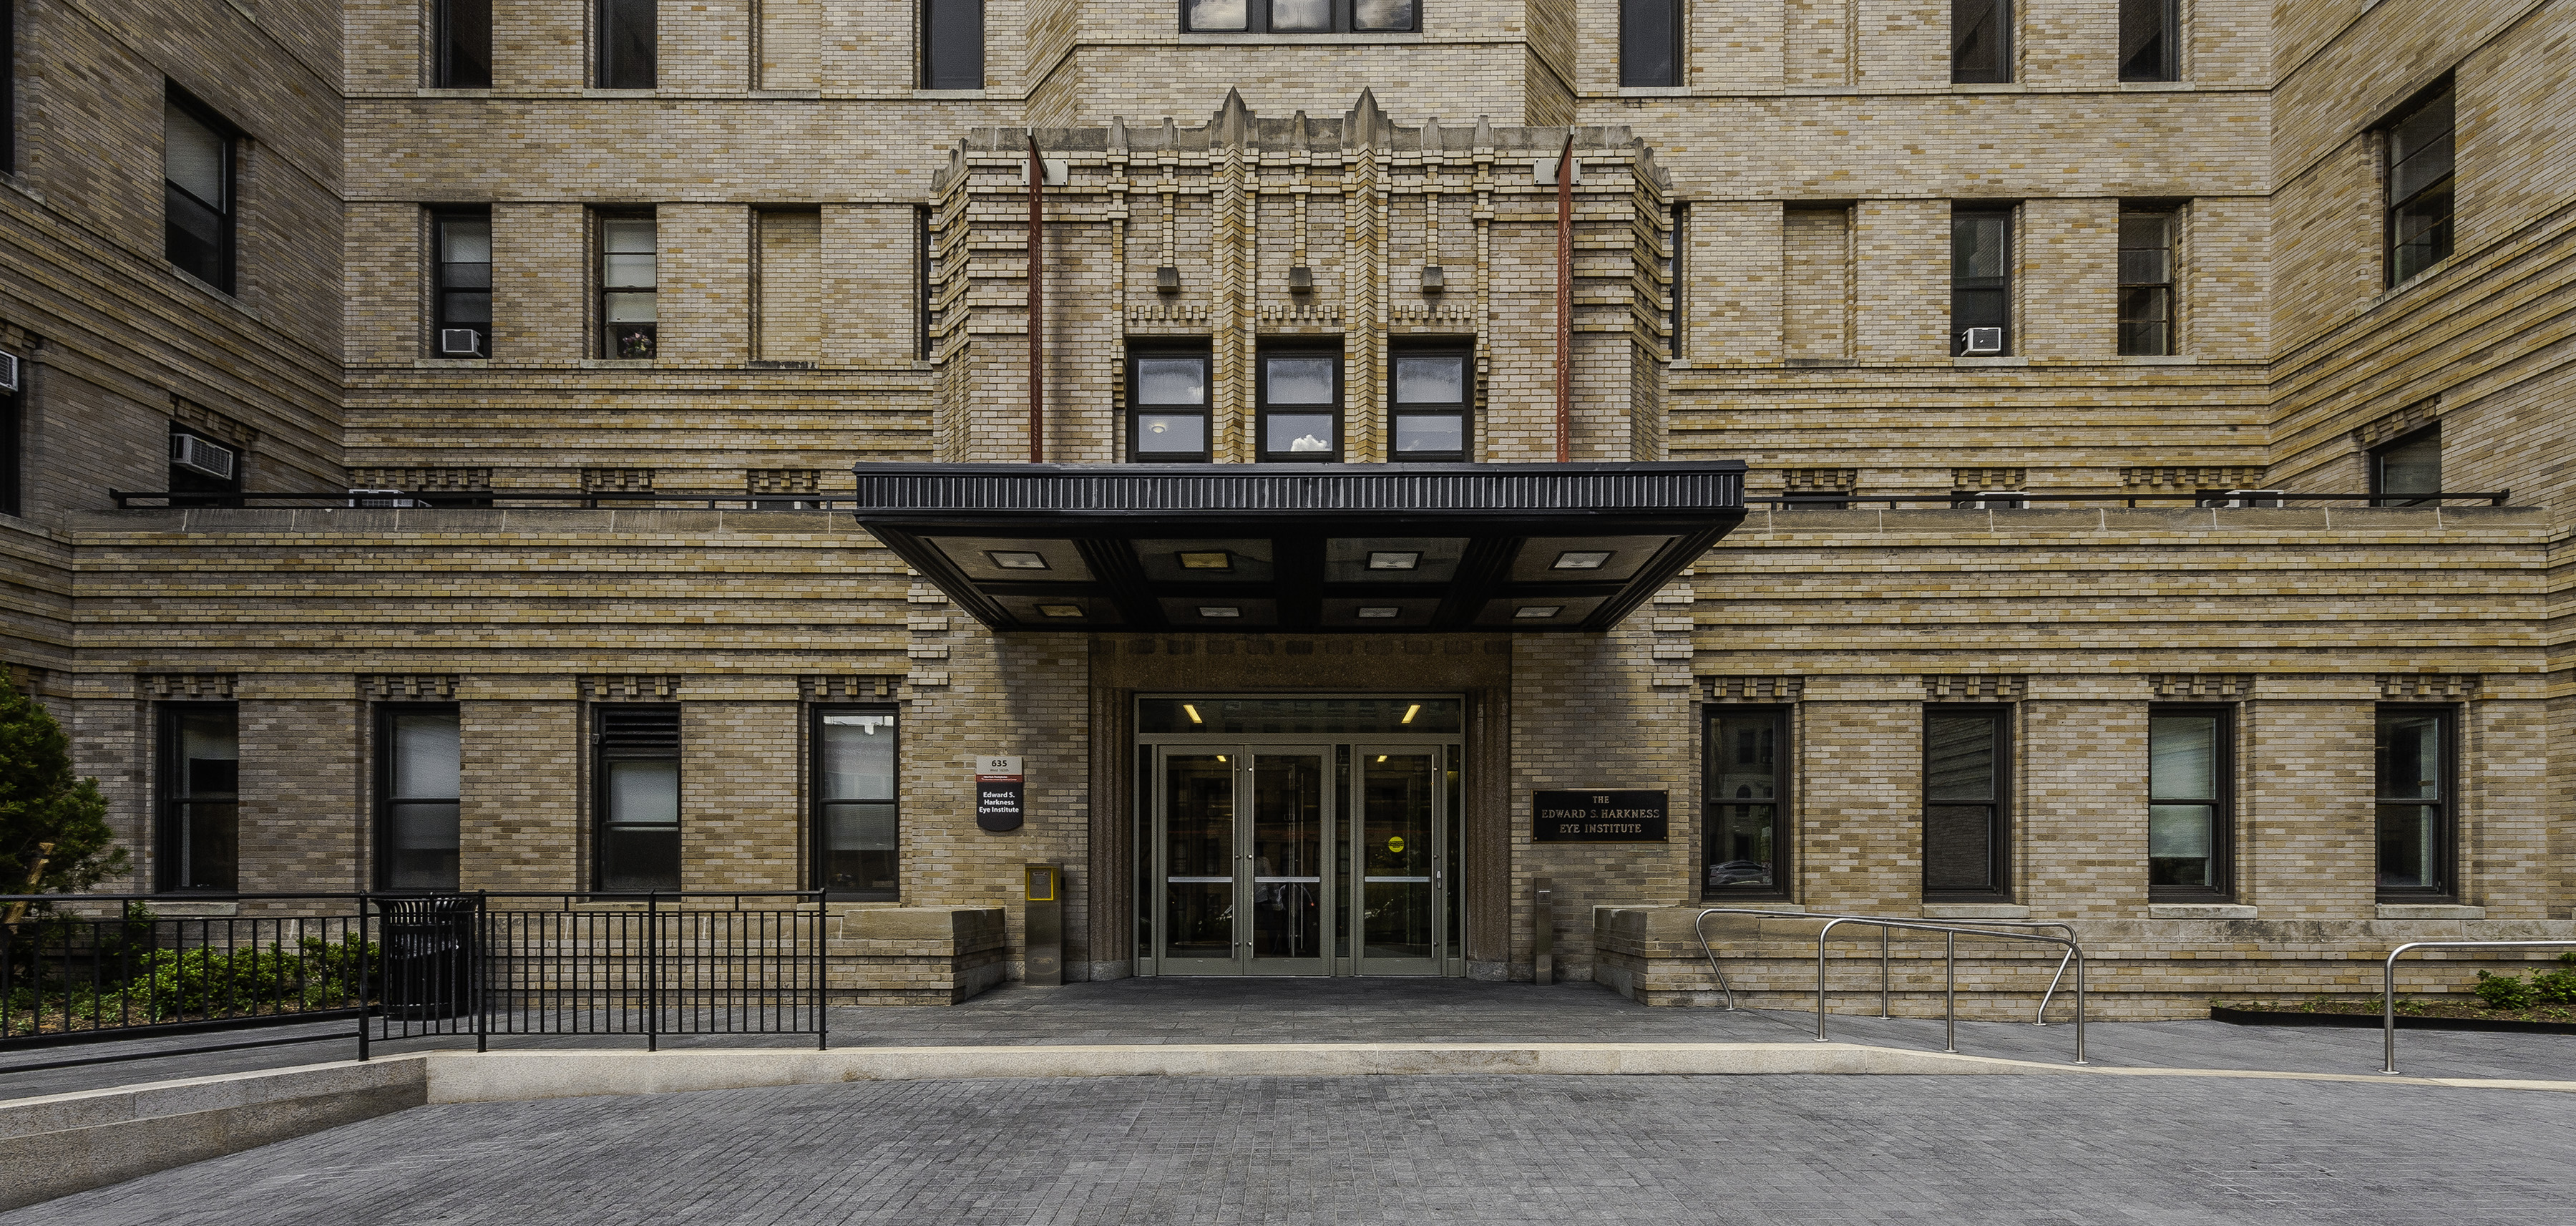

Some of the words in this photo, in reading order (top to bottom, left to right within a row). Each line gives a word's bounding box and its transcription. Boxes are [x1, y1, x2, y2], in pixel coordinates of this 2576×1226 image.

[1541, 809, 1586, 819] EDWARD
[1590, 809, 1599, 819] S.
[1601, 809, 1660, 819] HARKNESS
[1559, 824, 1581, 833] EYE
[1584, 824, 1642, 833] INSTITUTE
